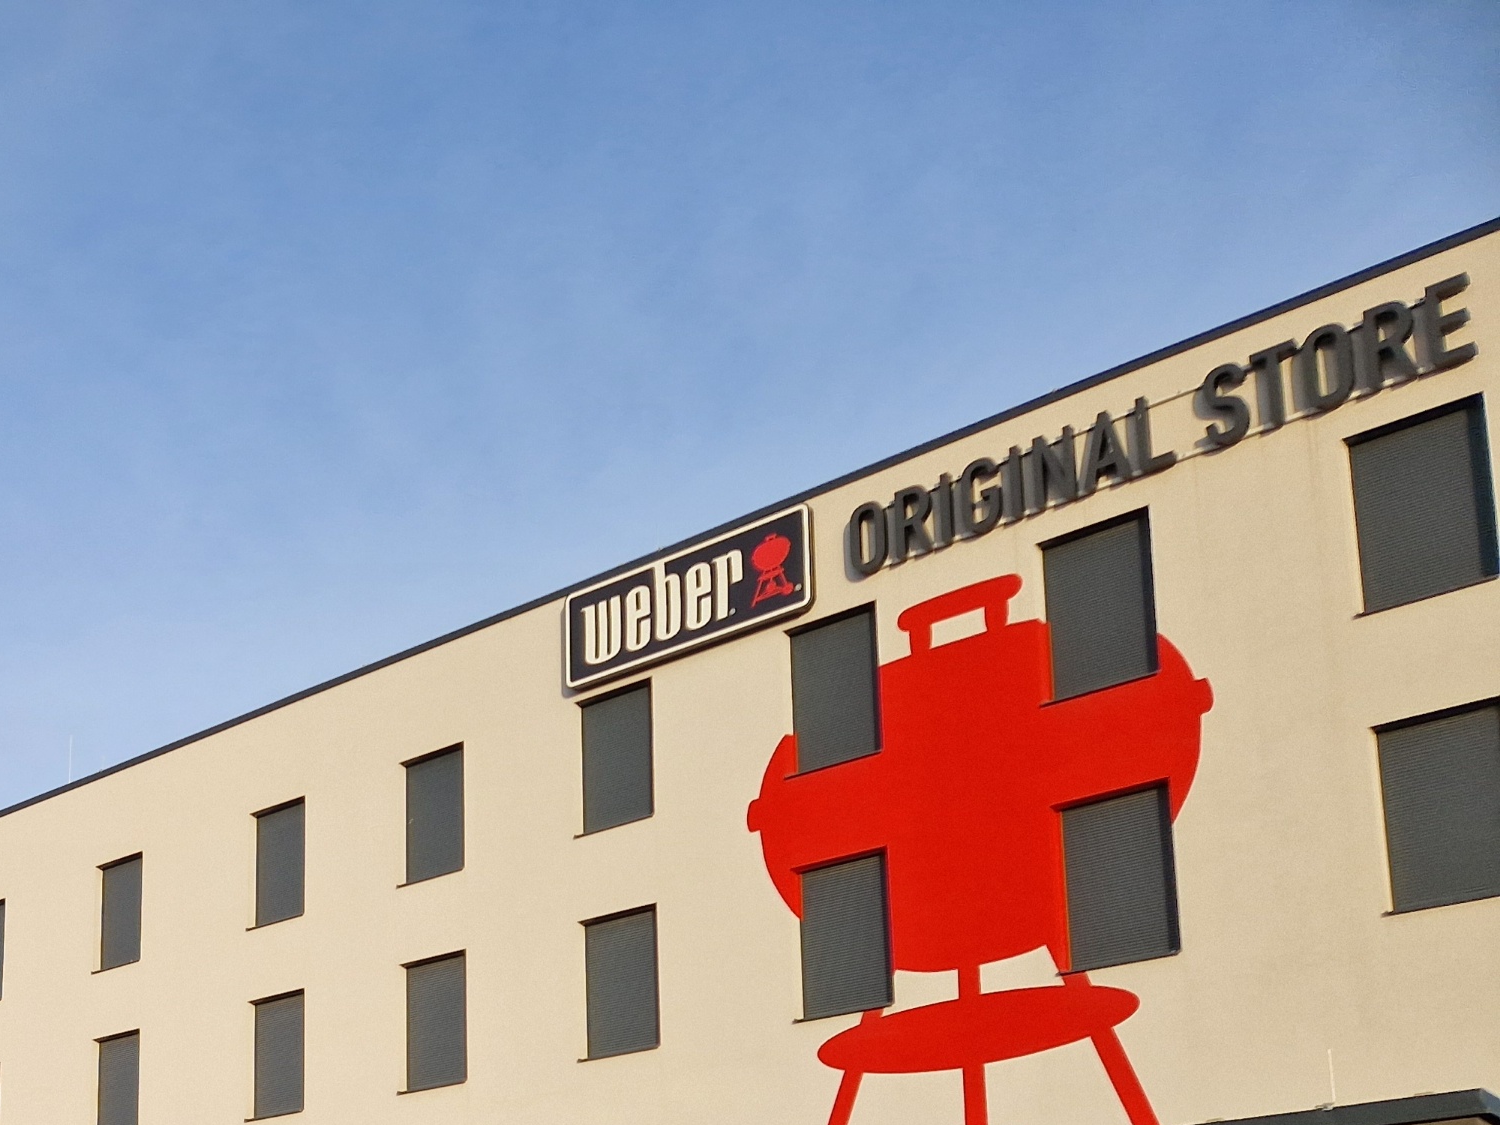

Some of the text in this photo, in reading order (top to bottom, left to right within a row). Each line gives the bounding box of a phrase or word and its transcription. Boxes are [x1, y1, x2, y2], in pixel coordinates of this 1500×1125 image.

[844, 272, 1479, 582] ORIGINAL STORE
[581, 549, 743, 665] weber
